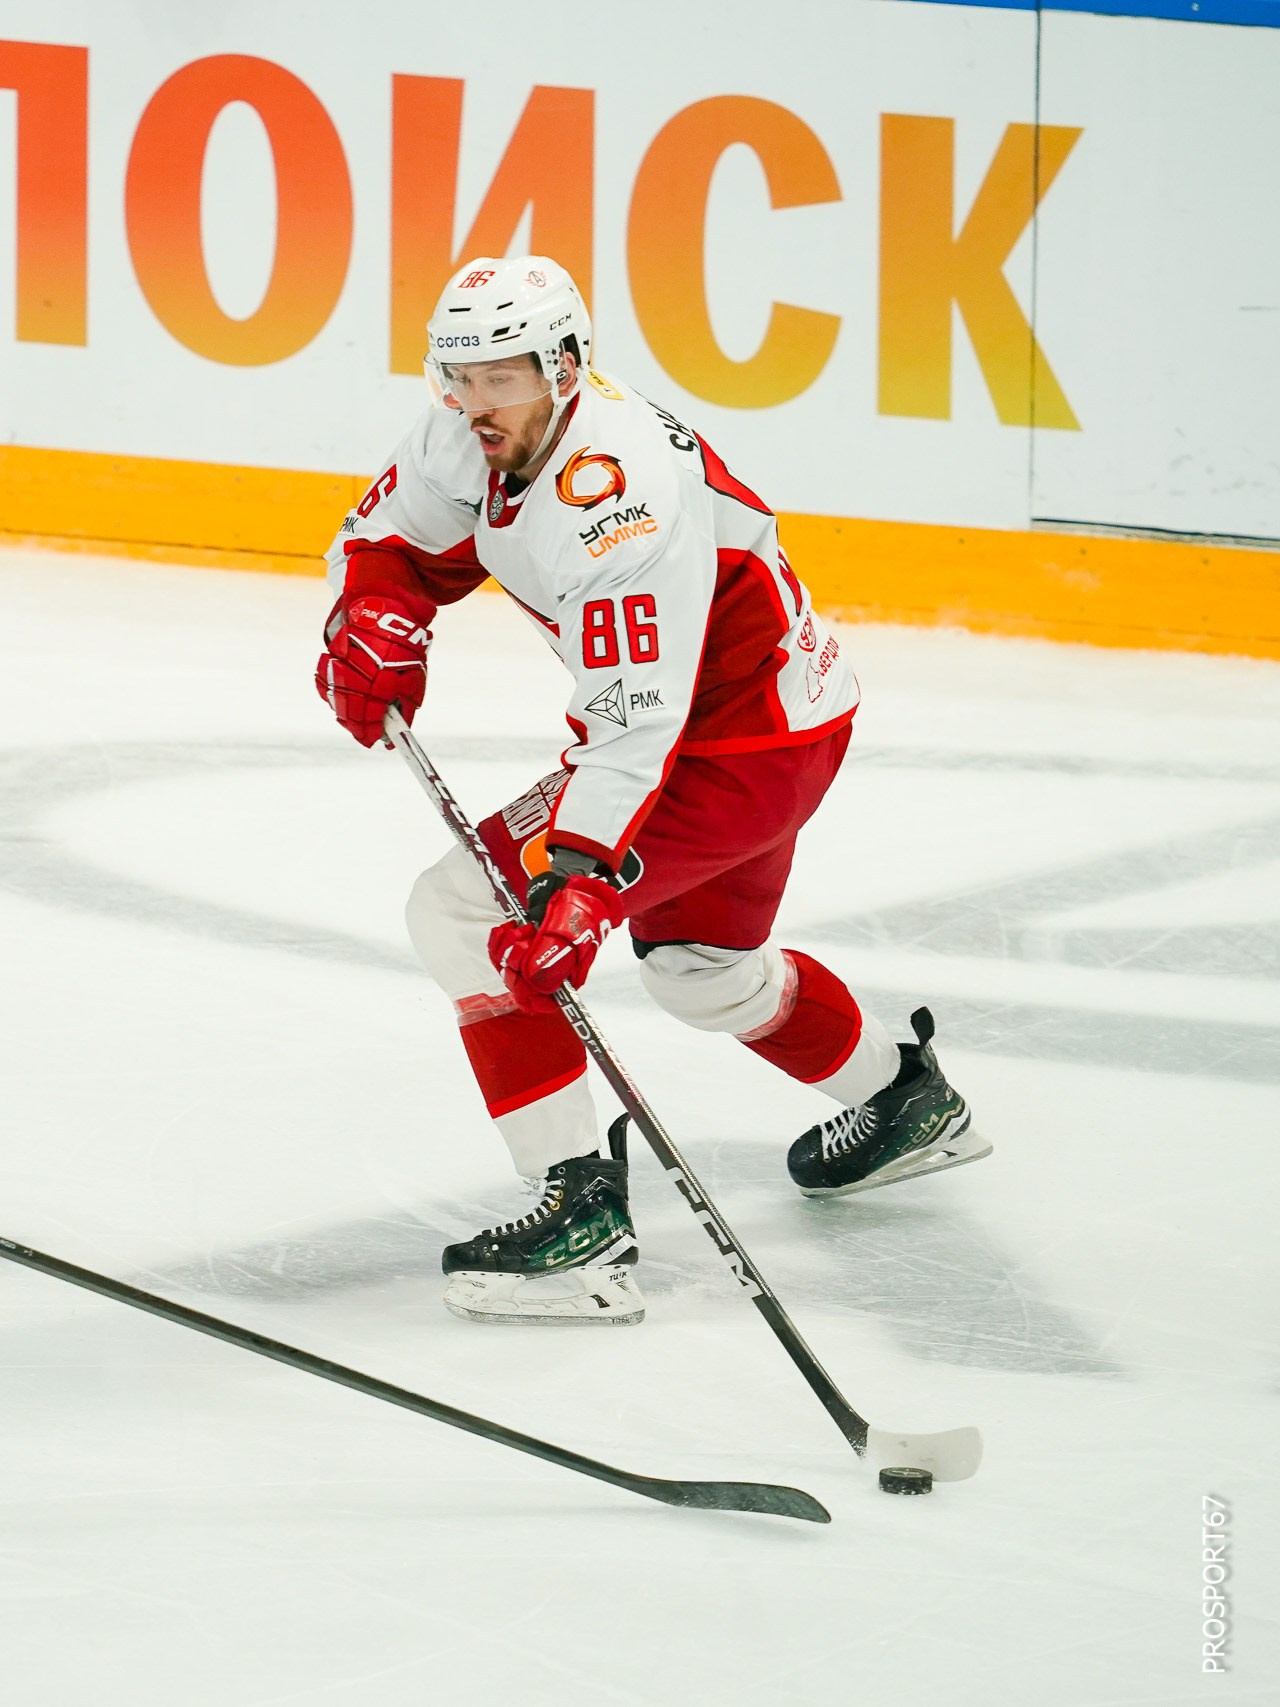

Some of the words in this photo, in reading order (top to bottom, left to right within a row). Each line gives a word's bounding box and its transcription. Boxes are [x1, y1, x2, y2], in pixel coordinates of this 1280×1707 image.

[457, 270, 496, 289] 86
[549, 312, 572, 332] CCM
[578, 502, 652, 546] УГМК
[587, 518, 658, 558] UMMC
[582, 593, 660, 670] 86
[544, 1210, 616, 1267] CCM
